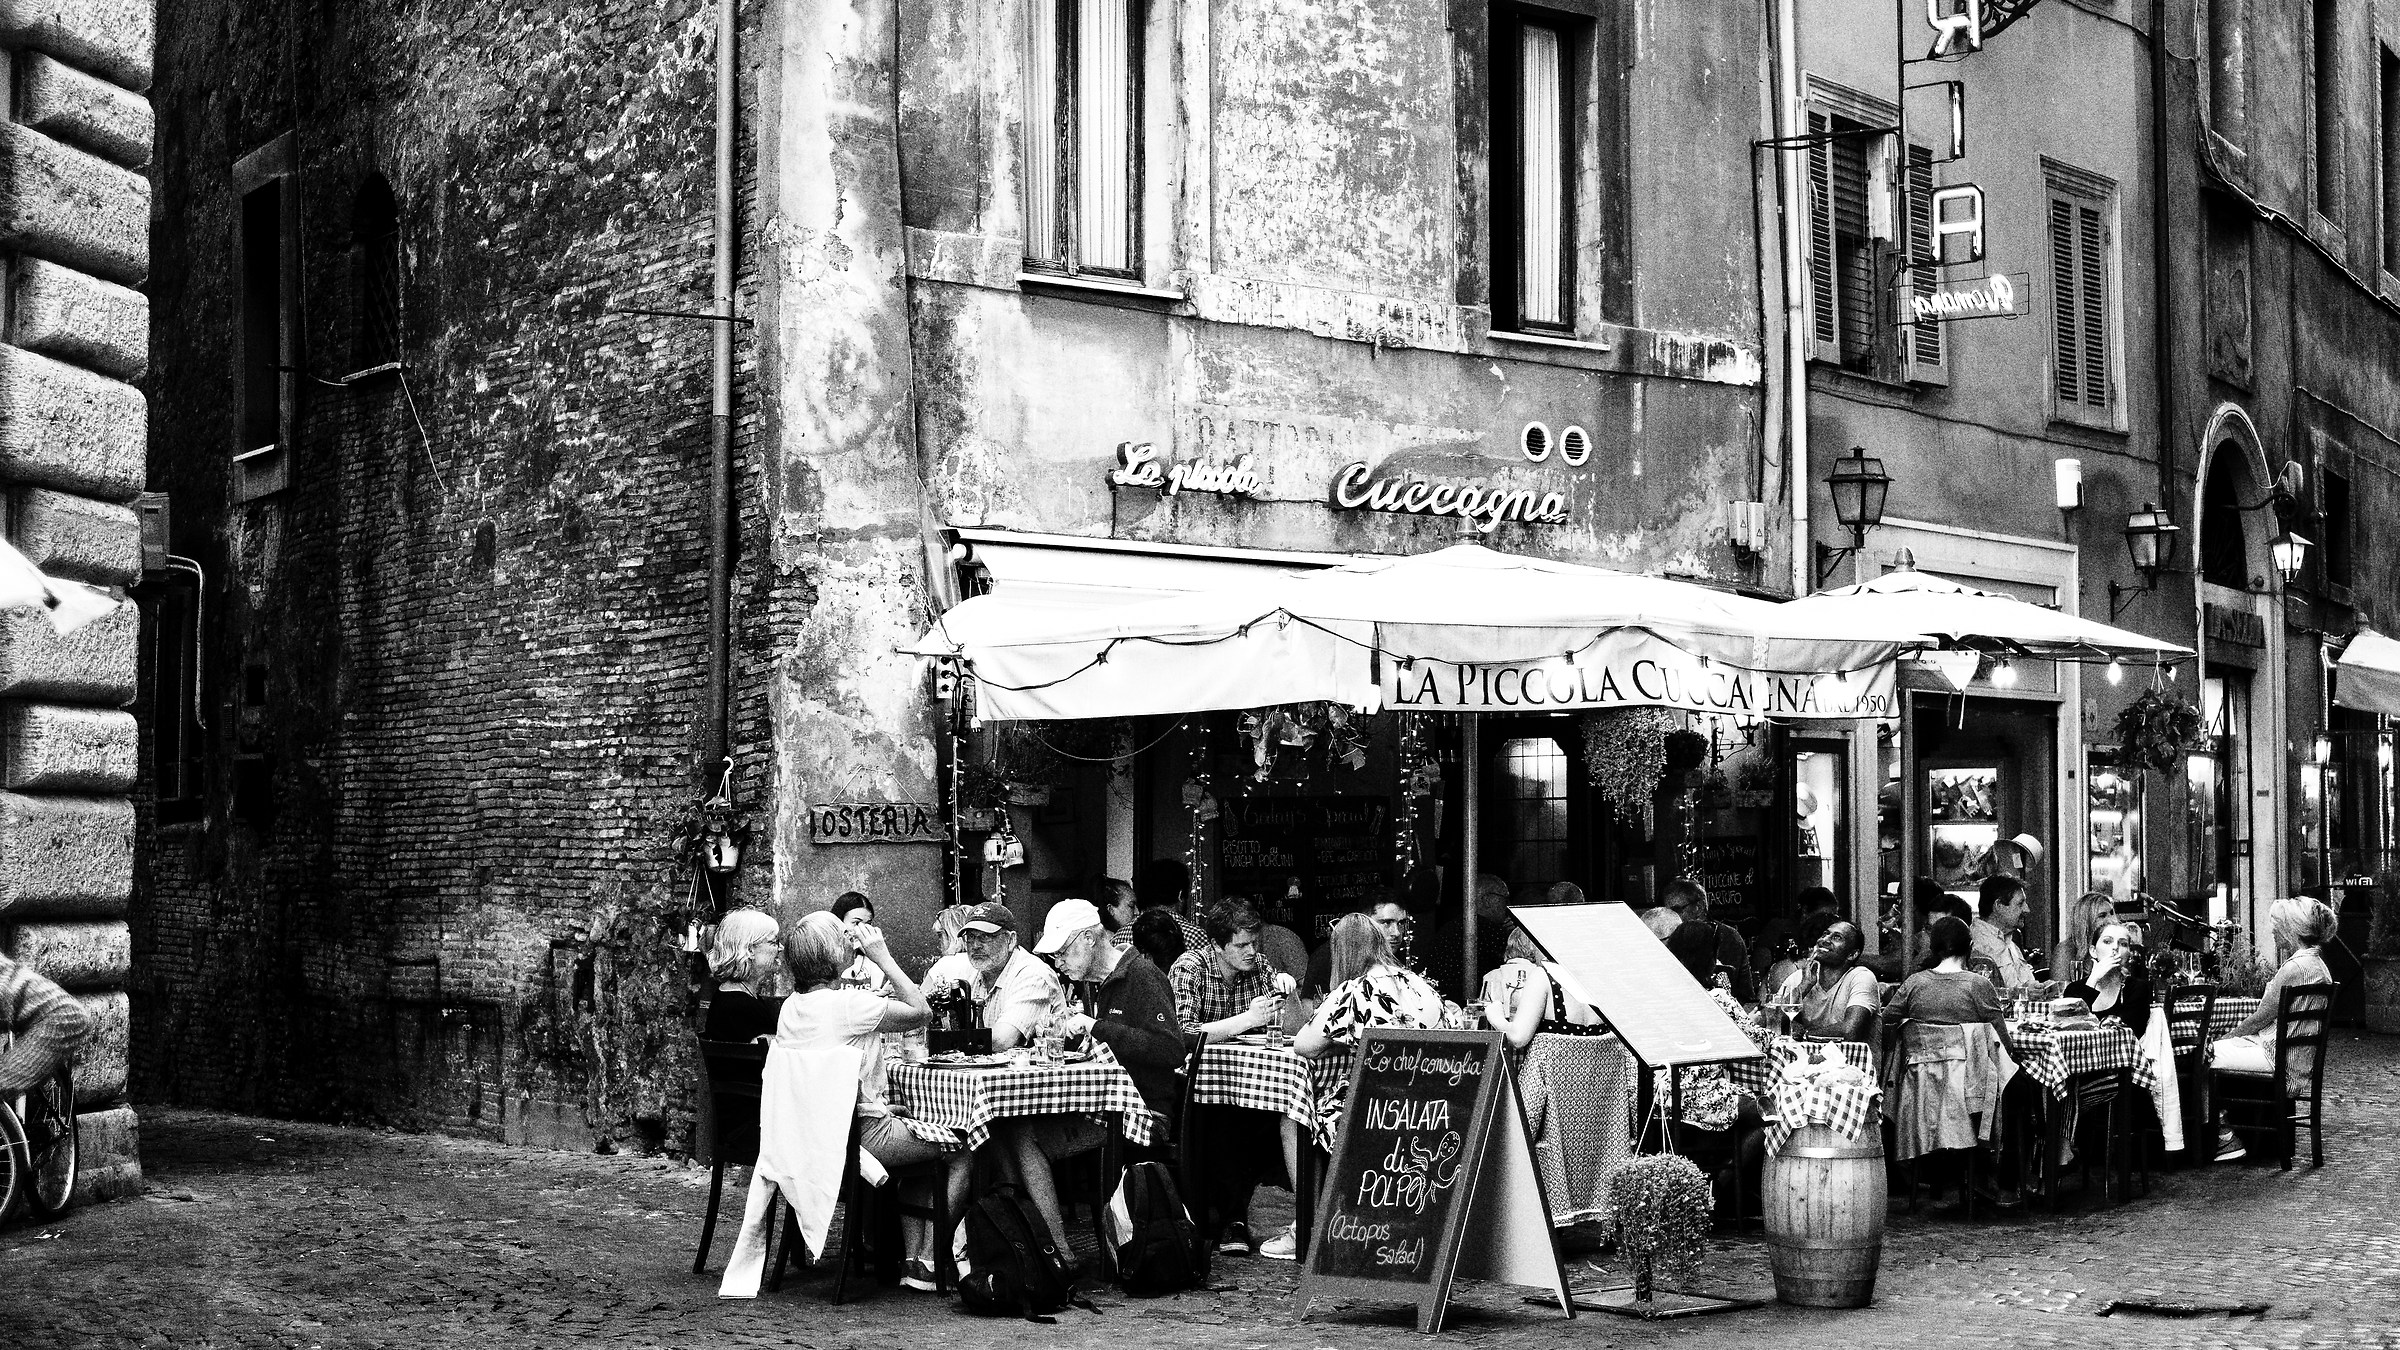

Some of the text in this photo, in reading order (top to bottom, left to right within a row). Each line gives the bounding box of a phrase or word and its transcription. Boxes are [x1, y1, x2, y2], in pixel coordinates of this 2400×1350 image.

[1112, 442, 1165, 488] La
[1336, 462, 1569, 533] Cuccagna
[1393, 658, 1442, 706] LA
[1456, 662, 1627, 706] PICCOLA
[1631, 659, 1821, 713] CUCCAGNA
[1856, 694, 1886, 712] 1950
[822, 806, 932, 837] OSTERIA
[1222, 839, 1261, 854] RISOTTO
[1364, 1042, 1481, 1086] Lo chef consiglia
[1366, 1098, 1449, 1131] INSALATA
[1384, 1137, 1406, 1174] di
[1357, 1170, 1423, 1208] POLPO
[1327, 1209, 1390, 1249] (Octopus
